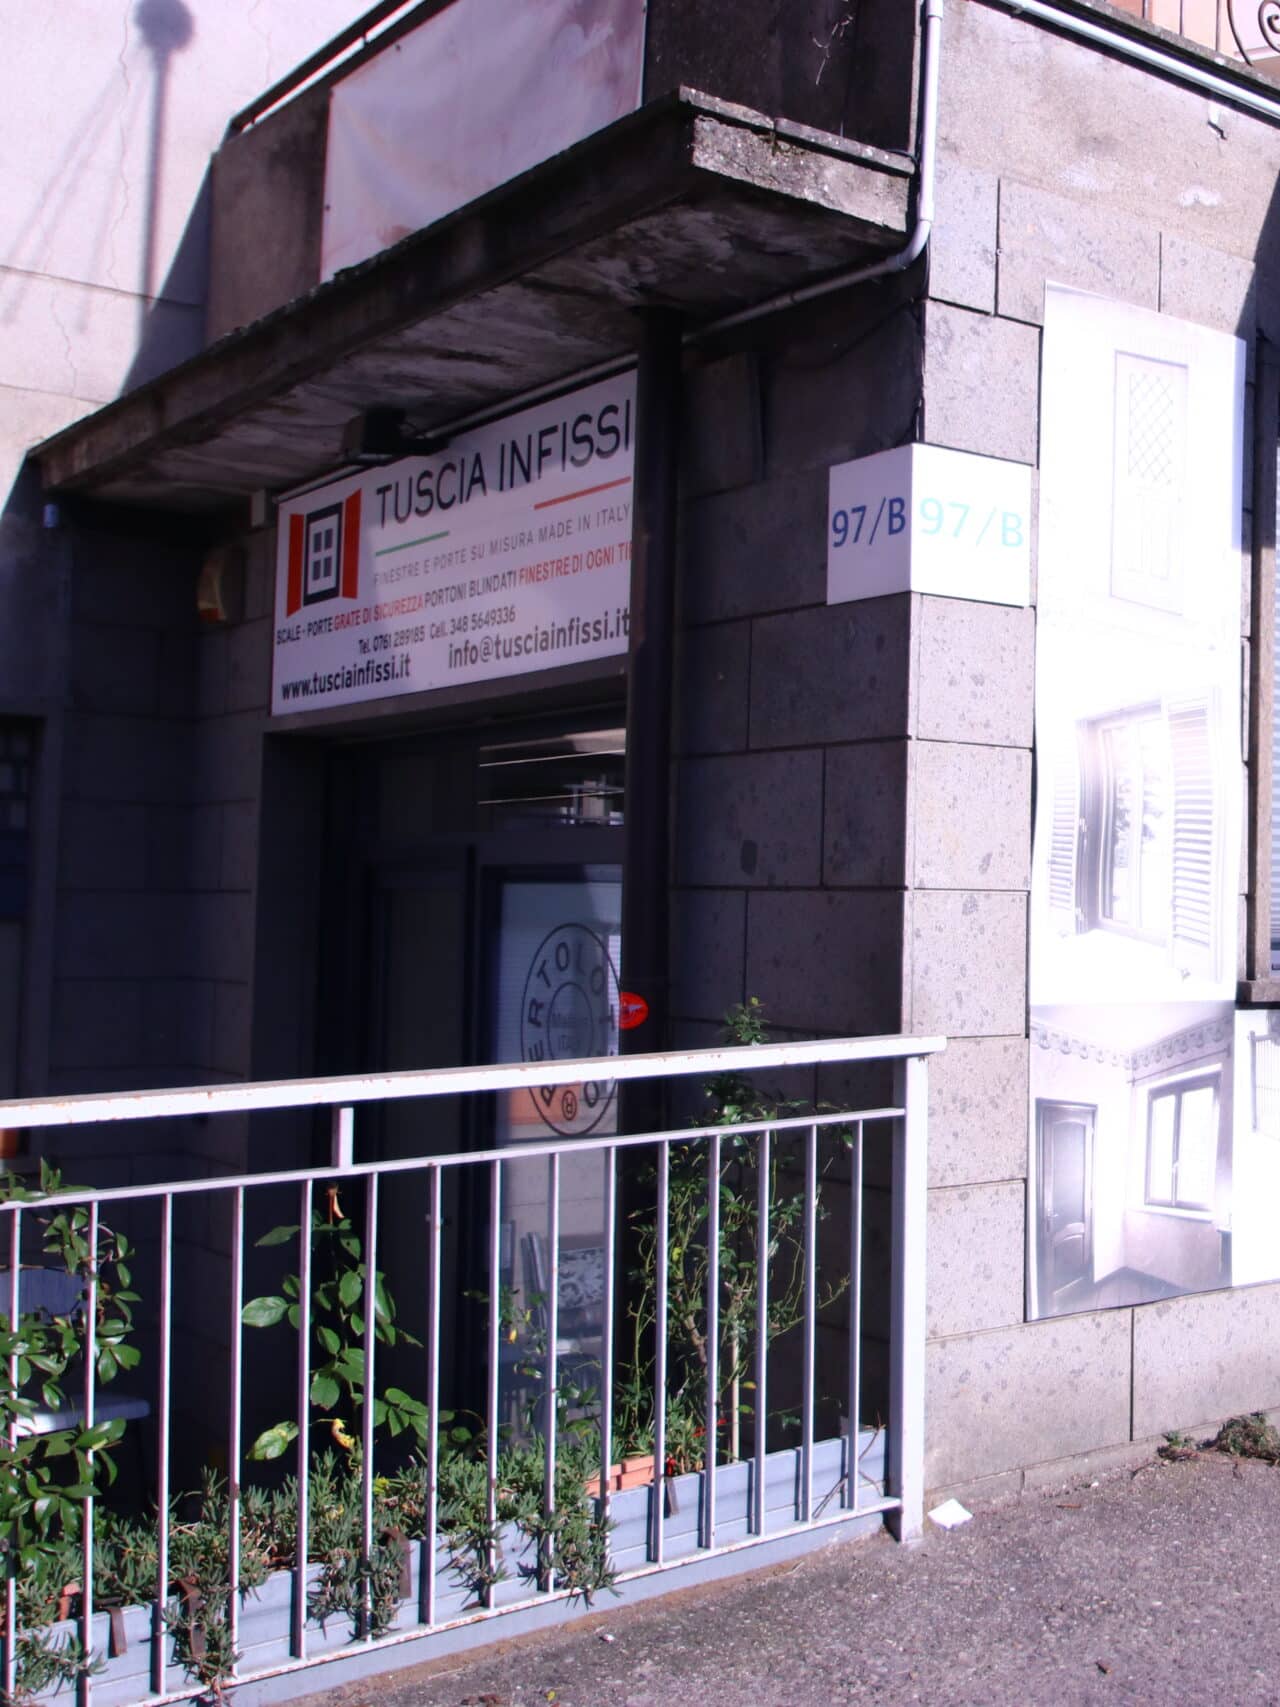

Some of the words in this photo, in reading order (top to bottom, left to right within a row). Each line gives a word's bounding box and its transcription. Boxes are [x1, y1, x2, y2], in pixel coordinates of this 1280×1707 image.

[376, 452, 488, 529] TUSCIA
[499, 399, 631, 492] INFISSI
[372, 561, 421, 586] FINESTRE
[423, 560, 431, 575] E
[433, 548, 467, 571] PORTE
[470, 542, 486, 562] SU
[489, 529, 535, 557] MISURA
[538, 519, 574, 544] MADE
[577, 514, 592, 532] IN
[596, 503, 631, 528] ITALY
[832, 496, 907, 548] 97/B
[919, 497, 1024, 548] 97/B
[276, 624, 301, 646] SCALE
[307, 616, 333, 639] PORTE
[333, 610, 361, 631] GRATE
[362, 607, 372, 625] DI
[373, 594, 424, 622] SICUREZZA
[424, 581, 468, 609] PORTONI
[468, 568, 517, 599] BLINDATI
[518, 556, 570, 586] FINESTRE
[572, 553, 583, 574] DI
[586, 546, 615, 571] OGNI
[373, 633, 392, 653] 0761
[393, 624, 426, 648] 289185
[450, 613, 469, 635] 348
[471, 604, 517, 632] 5649336
[281, 652, 412, 701] www.tusciainfissi.it
[448, 607, 632, 669] info@tusciainfissi.it
